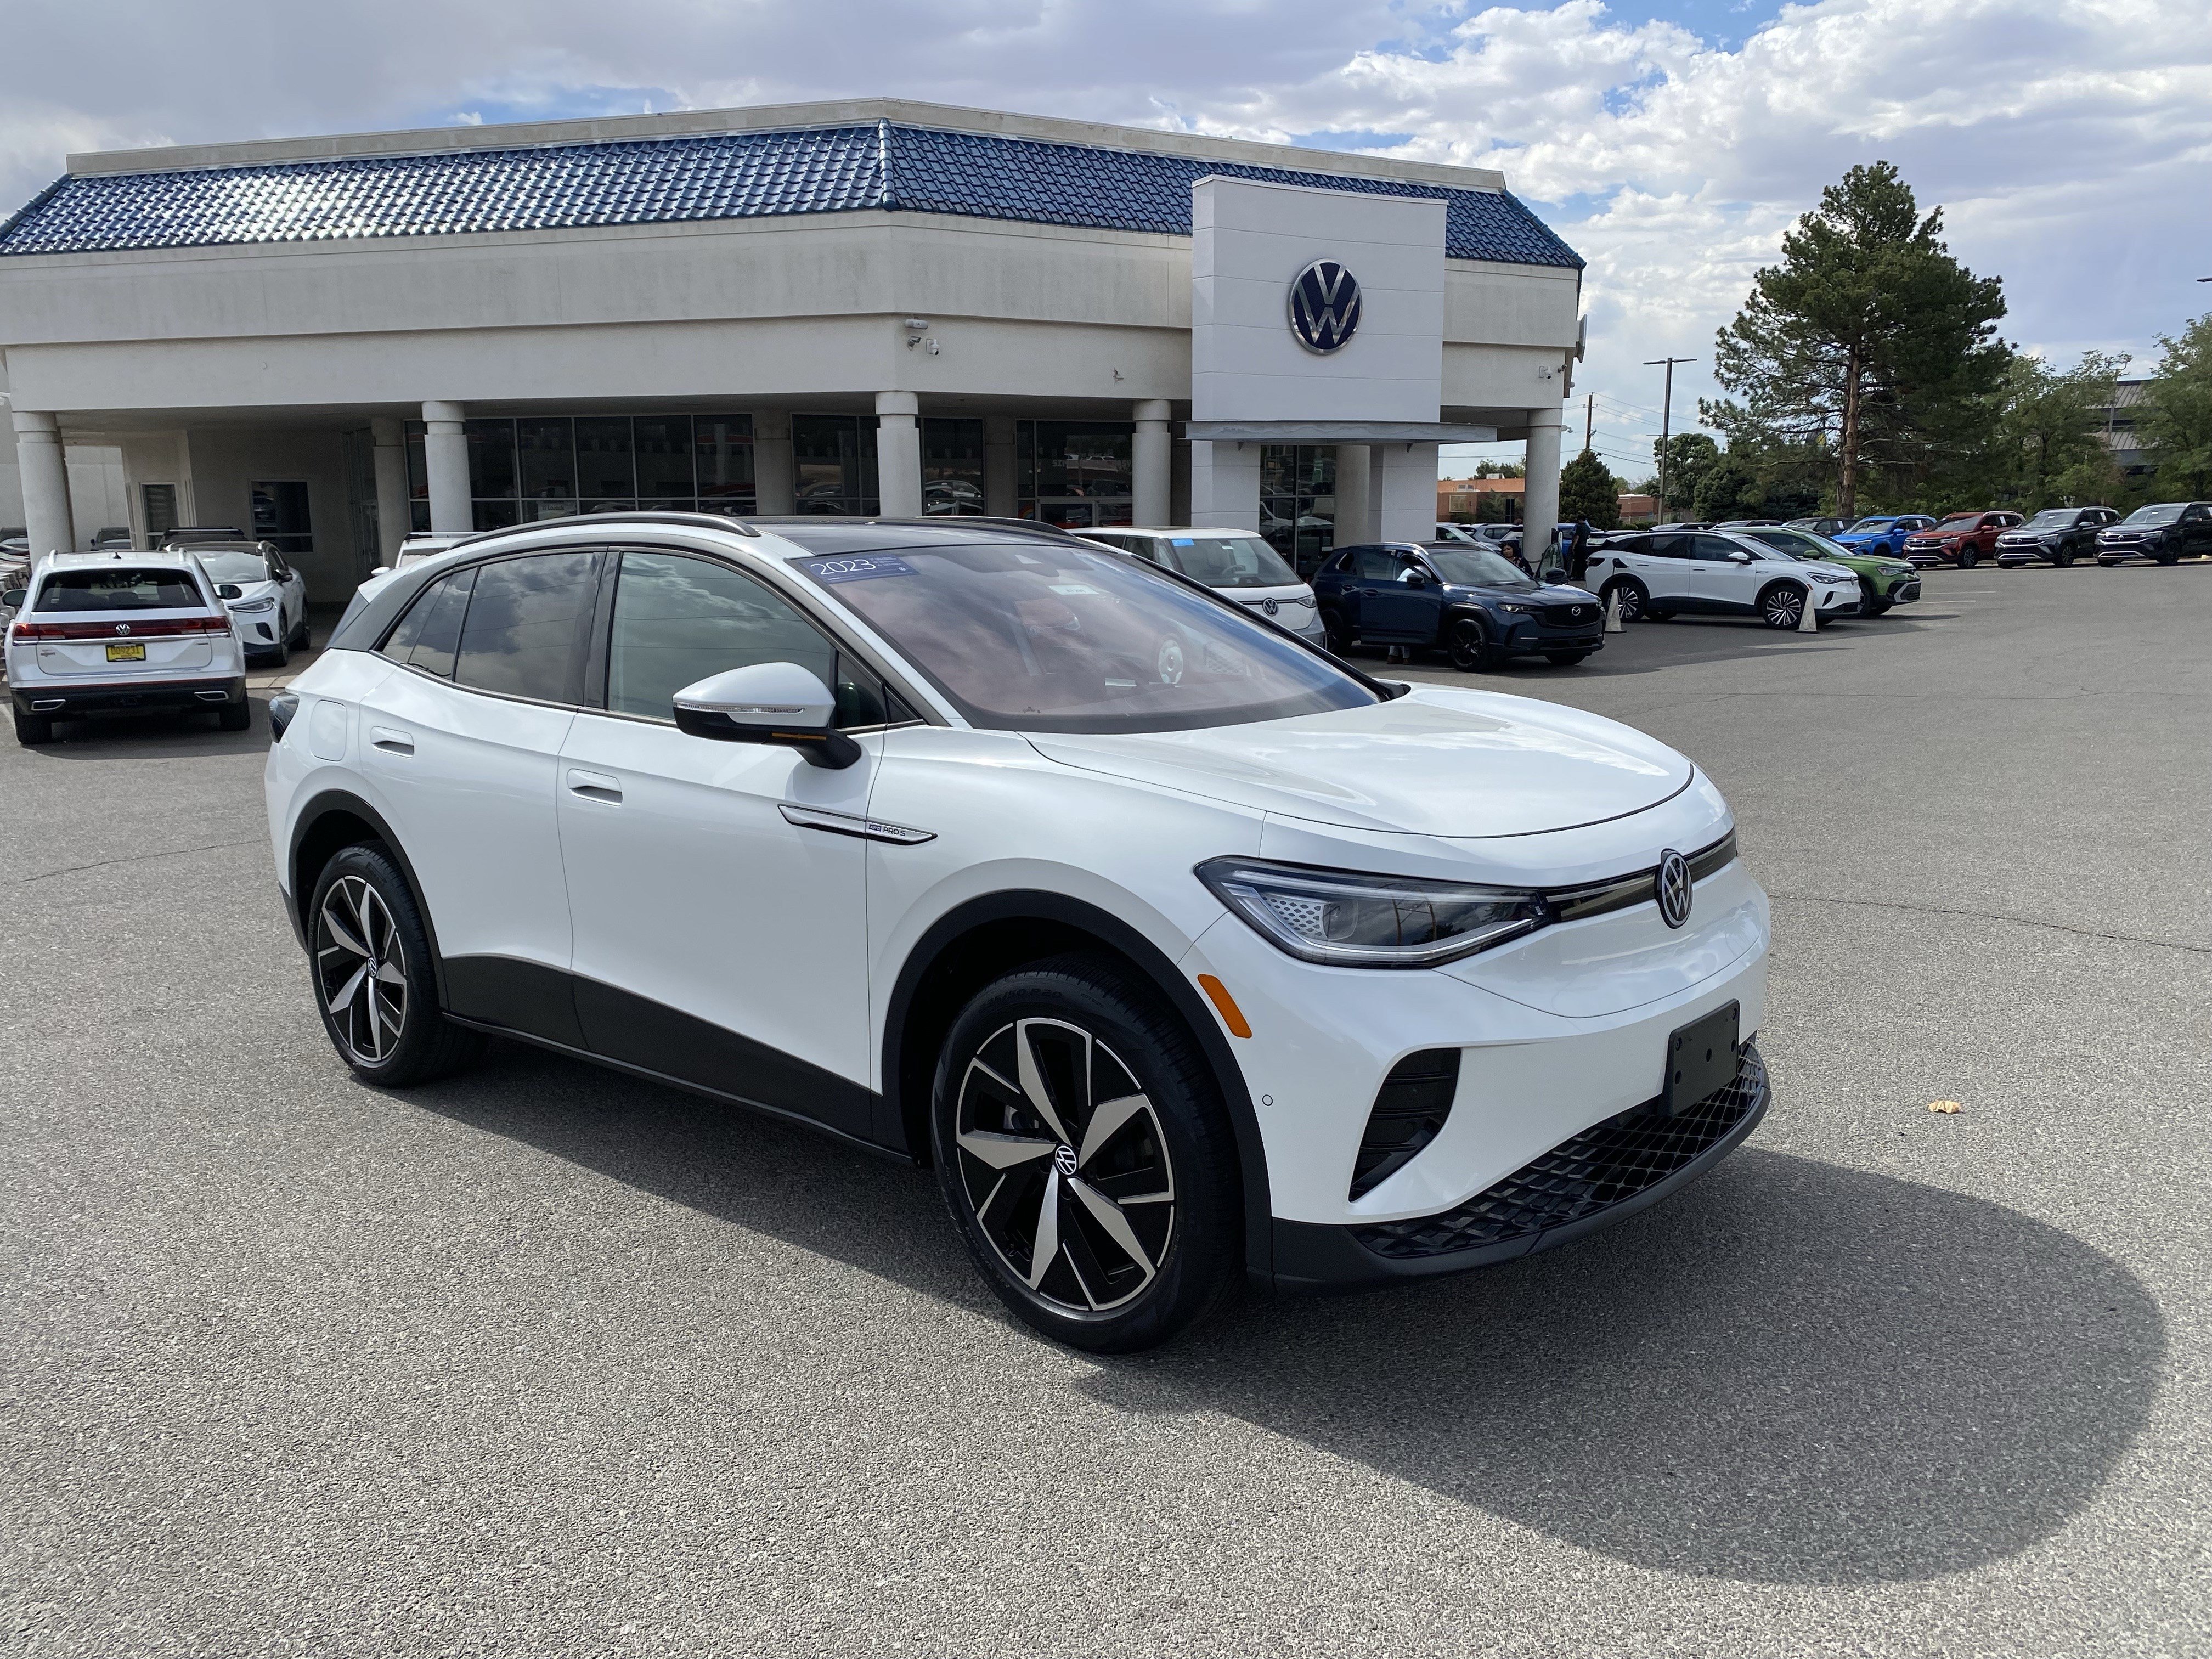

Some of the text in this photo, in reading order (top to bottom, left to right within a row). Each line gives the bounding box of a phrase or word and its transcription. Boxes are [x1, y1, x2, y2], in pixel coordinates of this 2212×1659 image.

[1295, 263, 1362, 347] VW
[810, 559, 876, 575] 2023
[1263, 599, 1278, 615] VW
[883, 827, 899, 835] PRO
[1663, 855, 1691, 922] VW
